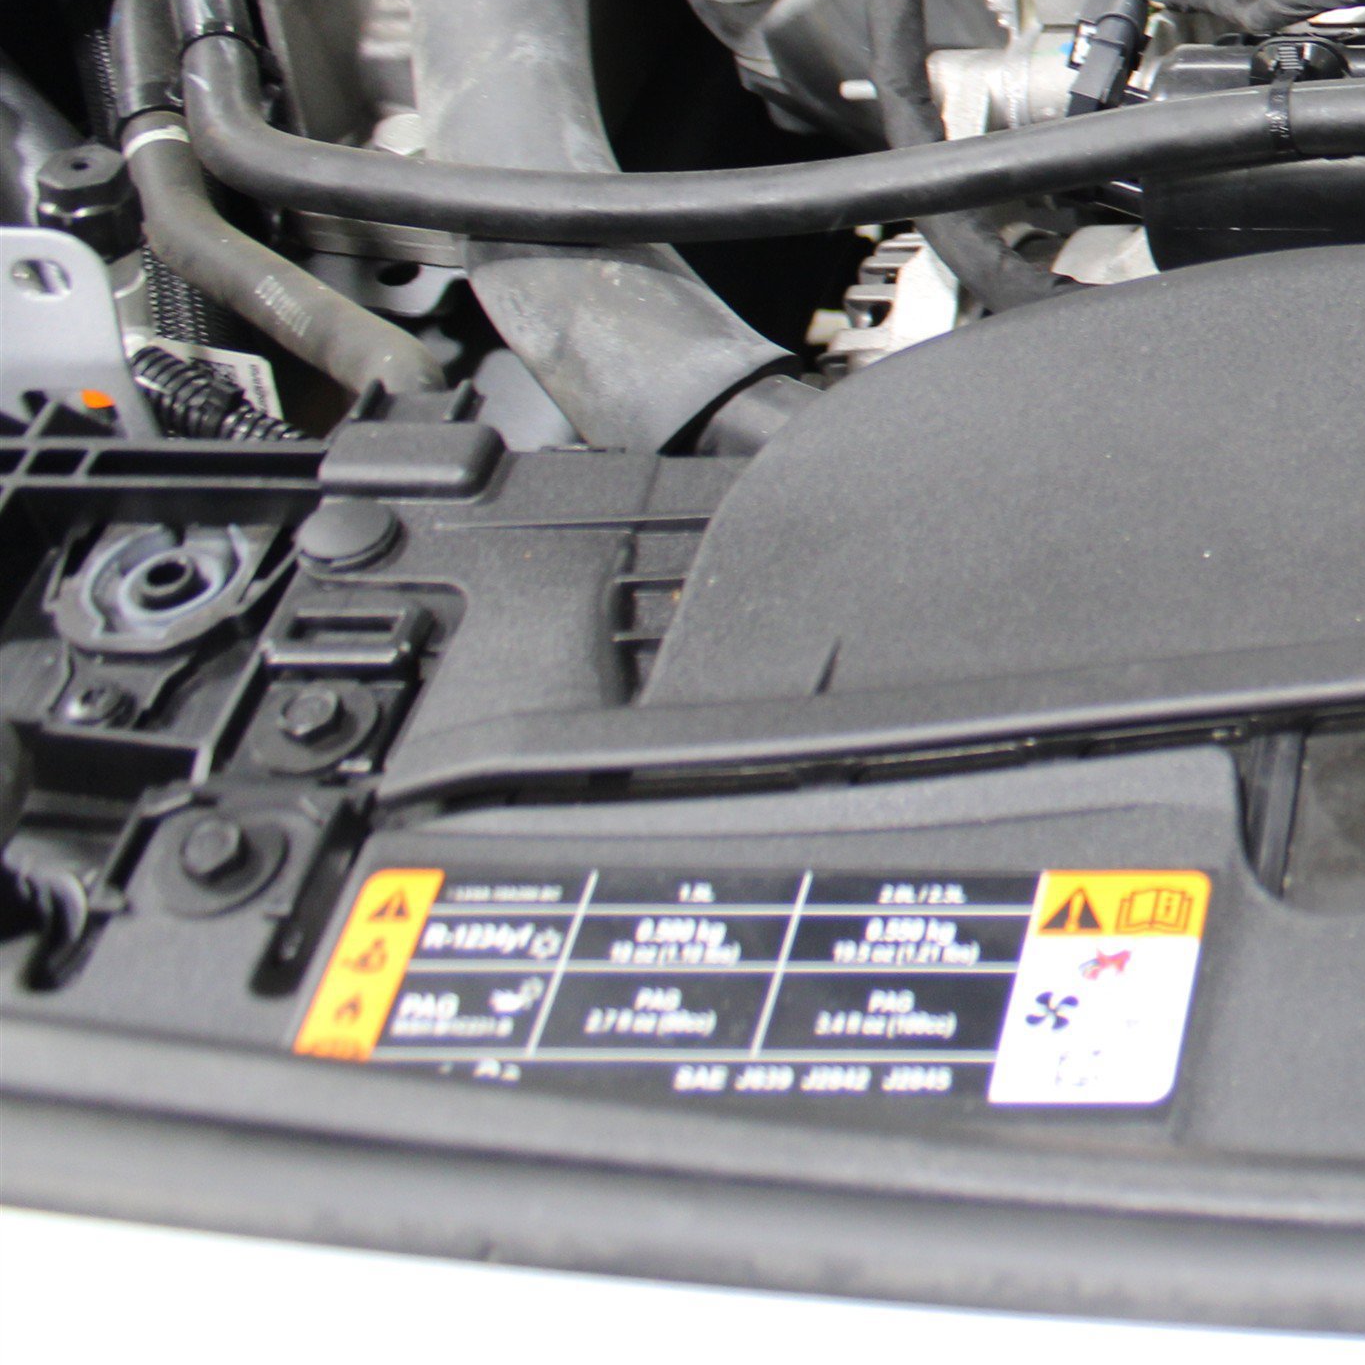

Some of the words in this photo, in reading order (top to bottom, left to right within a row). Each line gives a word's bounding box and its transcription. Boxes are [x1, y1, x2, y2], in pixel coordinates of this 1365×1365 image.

[696, 917, 727, 947] kg
[926, 917, 957, 947] kg
[673, 1064, 729, 1091] SAE
